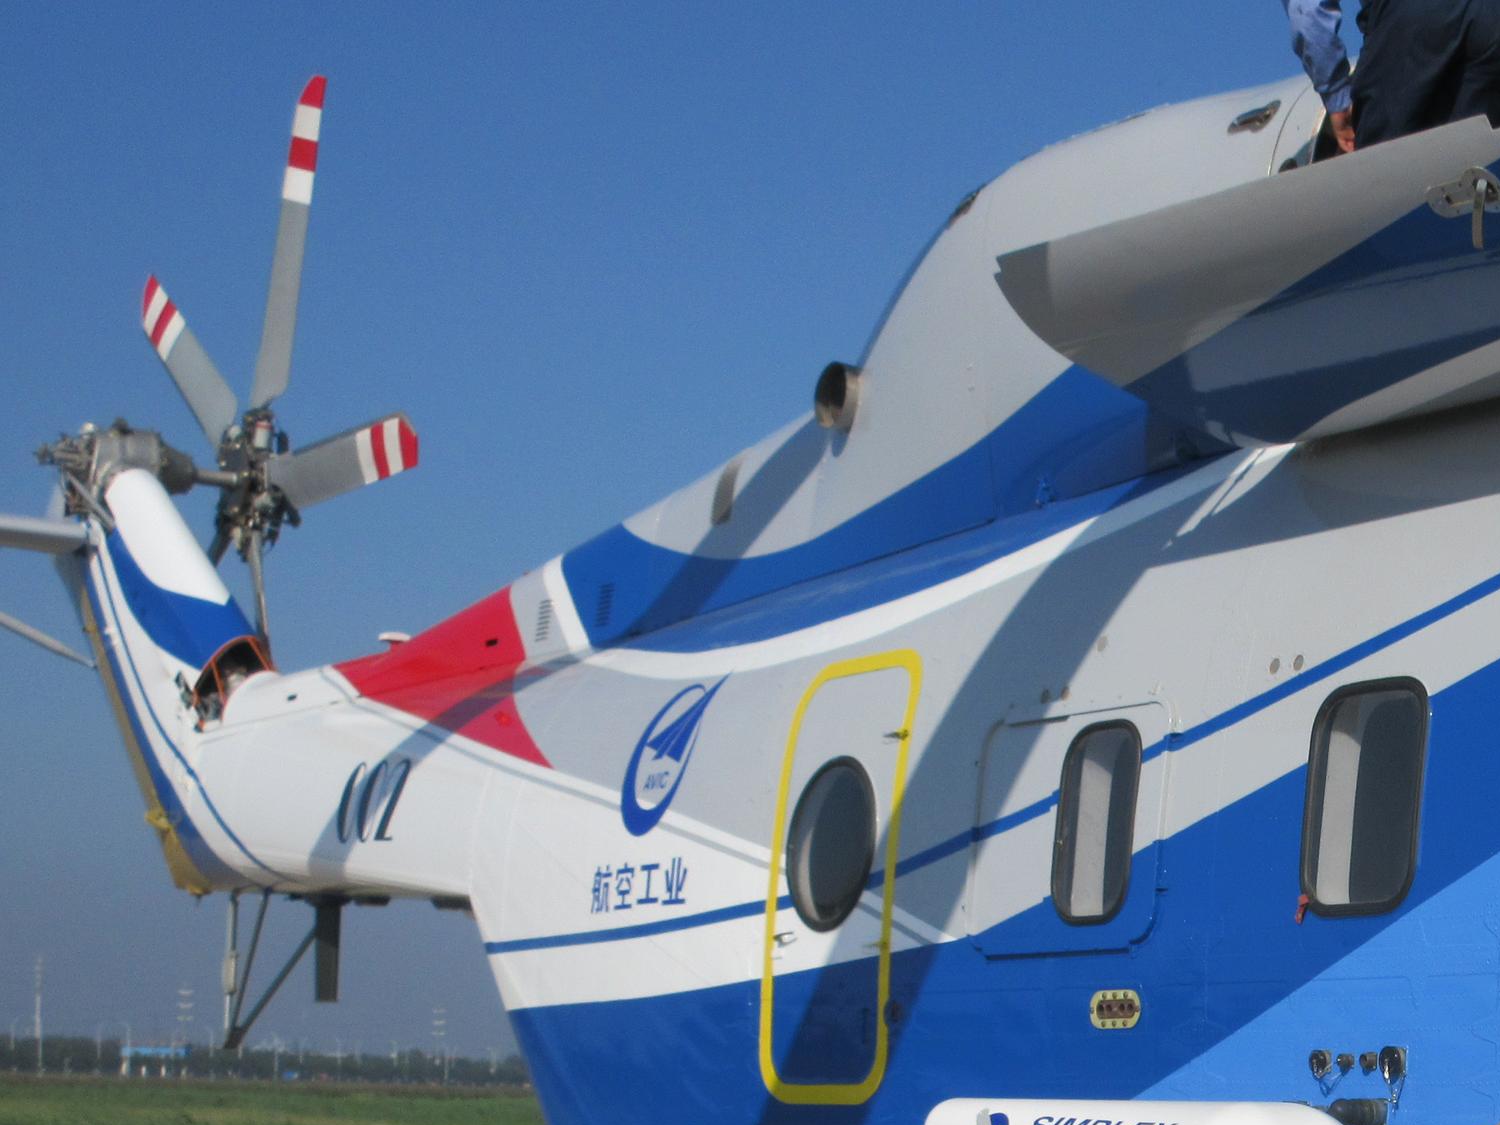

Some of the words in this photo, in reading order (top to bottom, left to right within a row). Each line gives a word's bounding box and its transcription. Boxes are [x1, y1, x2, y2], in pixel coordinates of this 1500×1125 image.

[337, 759, 411, 843] 002
[643, 771, 669, 790] AVIC
[591, 857, 687, 914] 航空工业
